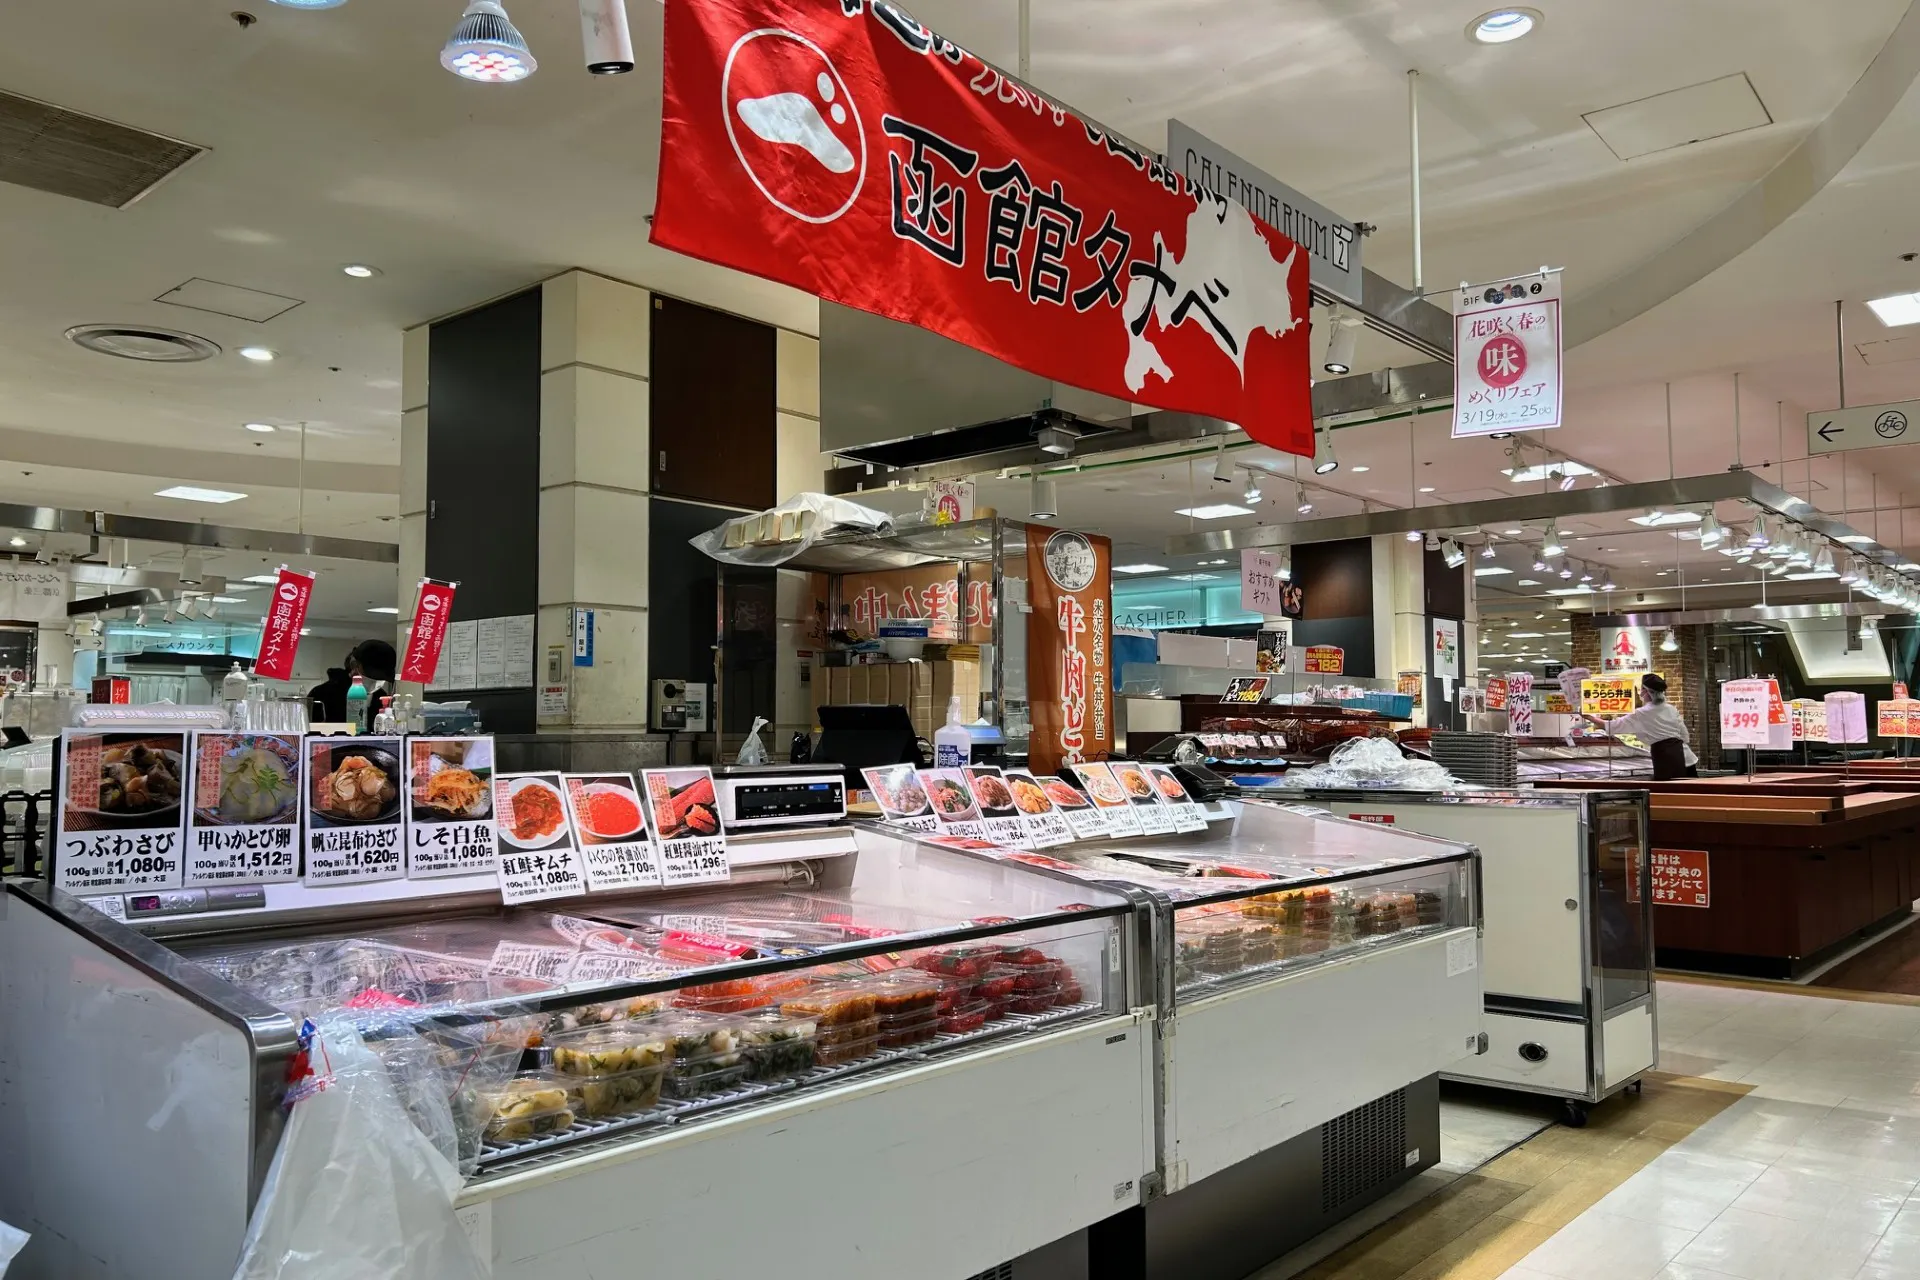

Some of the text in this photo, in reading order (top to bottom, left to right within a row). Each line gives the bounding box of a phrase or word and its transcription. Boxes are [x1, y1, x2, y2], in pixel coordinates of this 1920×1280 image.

[881, 113, 1239, 357] 函館タナベ
[1463, 295, 1480, 306] B1F
[1469, 312, 1546, 338] 花咲く春の
[1485, 343, 1520, 378] 味
[1468, 382, 1546, 404] めぐりフェア
[1248, 570, 1275, 588] おすすめ
[1252, 589, 1271, 605] ギフト
[1113, 610, 1187, 629] CASHIER
[134, 639, 225, 651] サビスカウンター
[263, 601, 293, 670] 函館タナベ
[408, 612, 436, 675] 函館タナベ
[1092, 598, 1105, 740] 米沢名物 牛丼弁当
[1317, 659, 1340, 672] 182
[1583, 688, 1632, 698] 春うらら弁当
[1600, 698, 1629, 710] 627
[938, 752, 959, 766] 除菌
[66, 832, 176, 857] つぶわさび
[198, 828, 291, 851] 甲いかとび卵
[311, 827, 398, 853] 帆立昆布わさび
[415, 825, 492, 847] しそ白魚
[237, 851, 292, 869] 1,512円
[351, 849, 399, 868] 1,620円
[450, 845, 493, 862] 1,080円
[115, 857, 176, 877] 1,080円
[502, 852, 573, 876] 紅鮭キムチ
[620, 862, 656, 876] 2,700円
[693, 856, 726, 871] 1,296円
[537, 870, 578, 887] 1,080円
